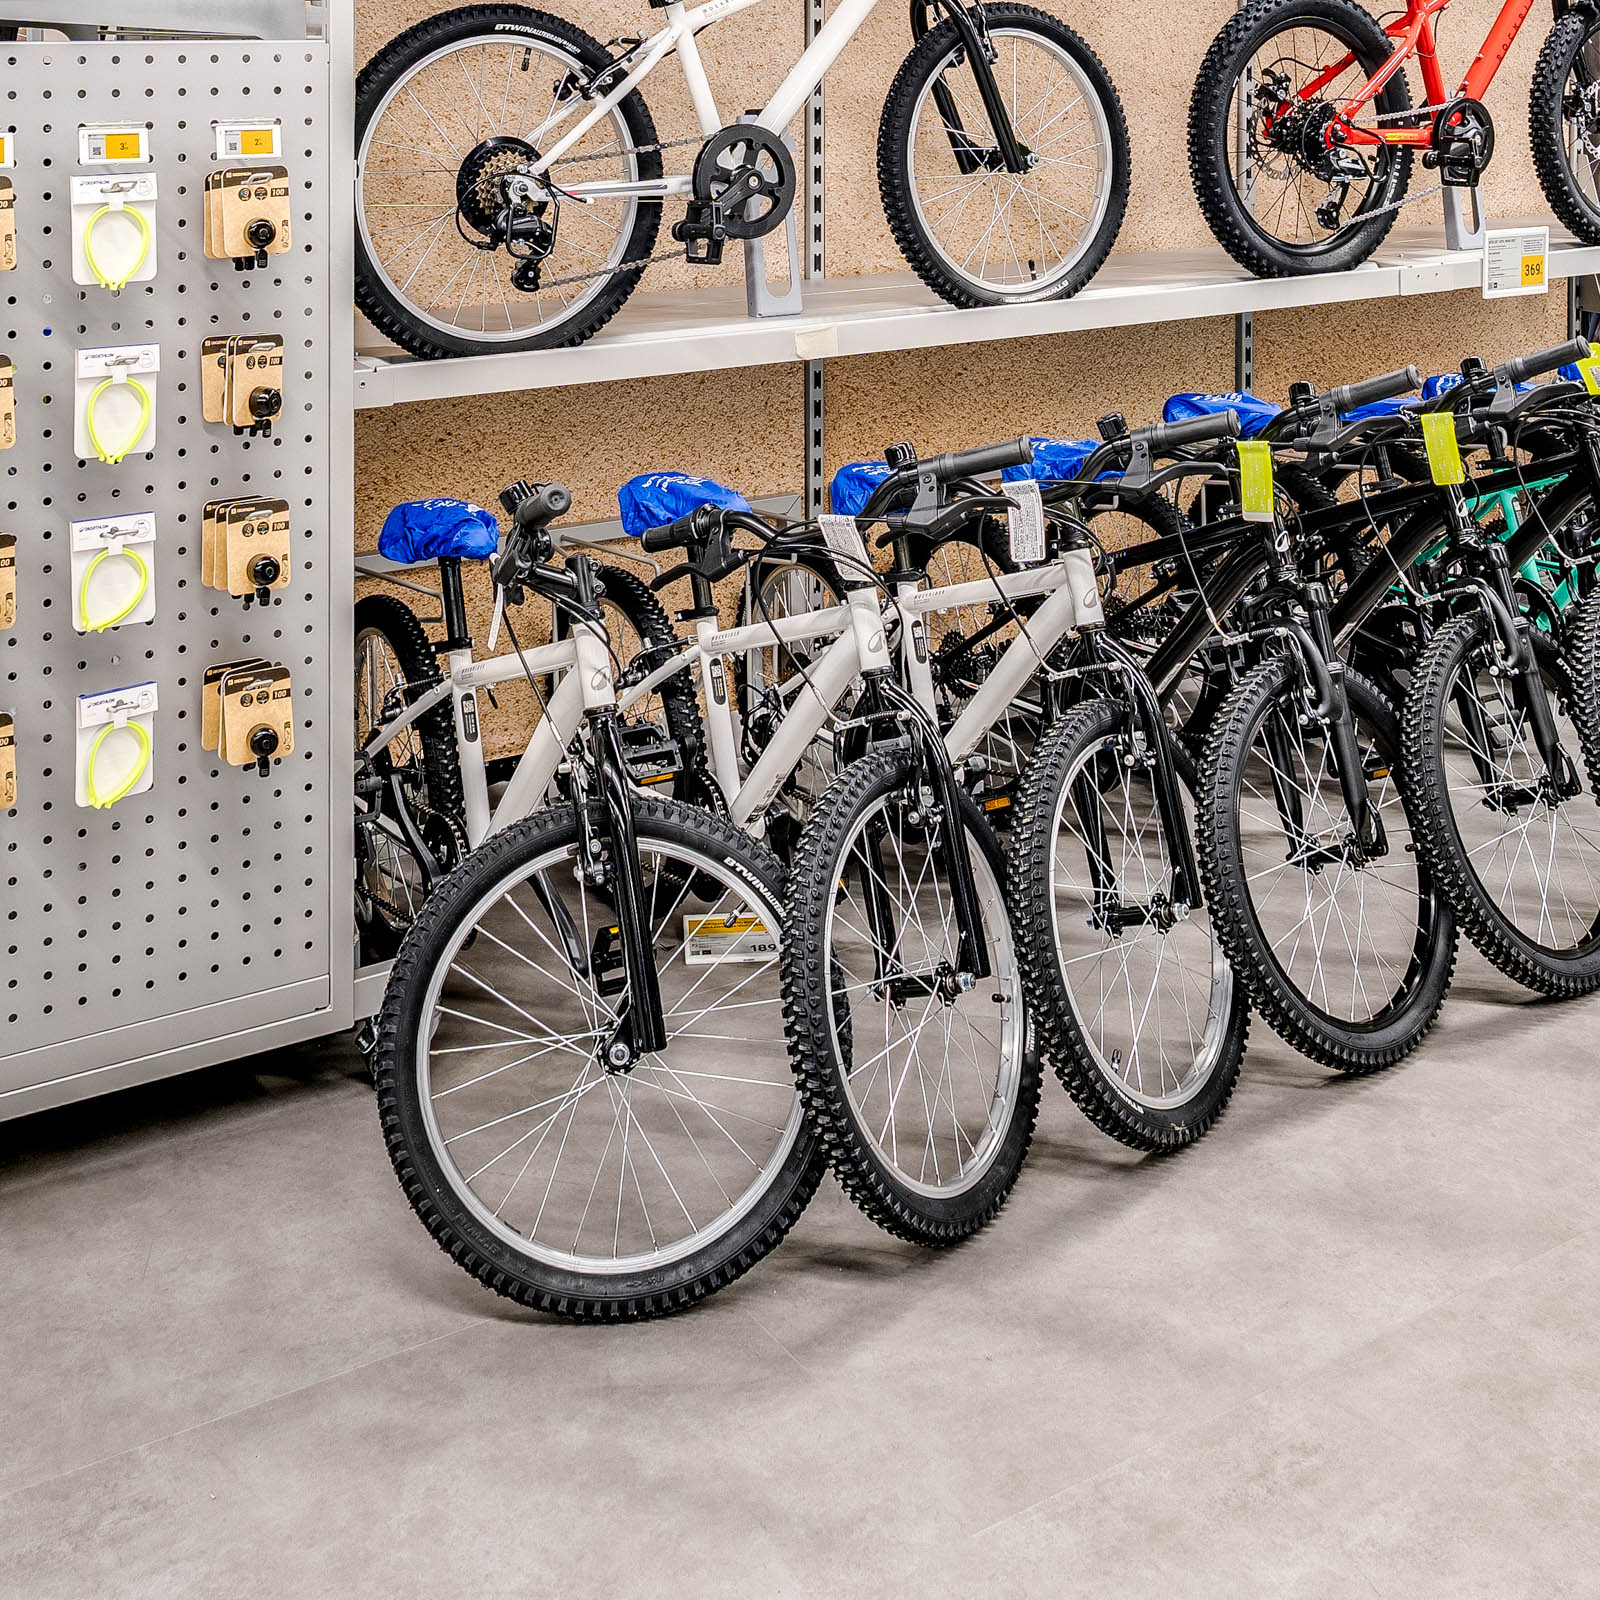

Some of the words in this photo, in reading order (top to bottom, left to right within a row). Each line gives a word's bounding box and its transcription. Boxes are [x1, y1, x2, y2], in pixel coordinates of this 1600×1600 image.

[494, 23, 534, 34] BTWIN
[271, 187, 285, 197] 100
[1524, 263, 1541, 277] 369
[273, 522, 286, 530] 100
[274, 689, 287, 698] 100
[723, 856, 766, 895] BTWIN
[750, 943, 777, 952] 189
